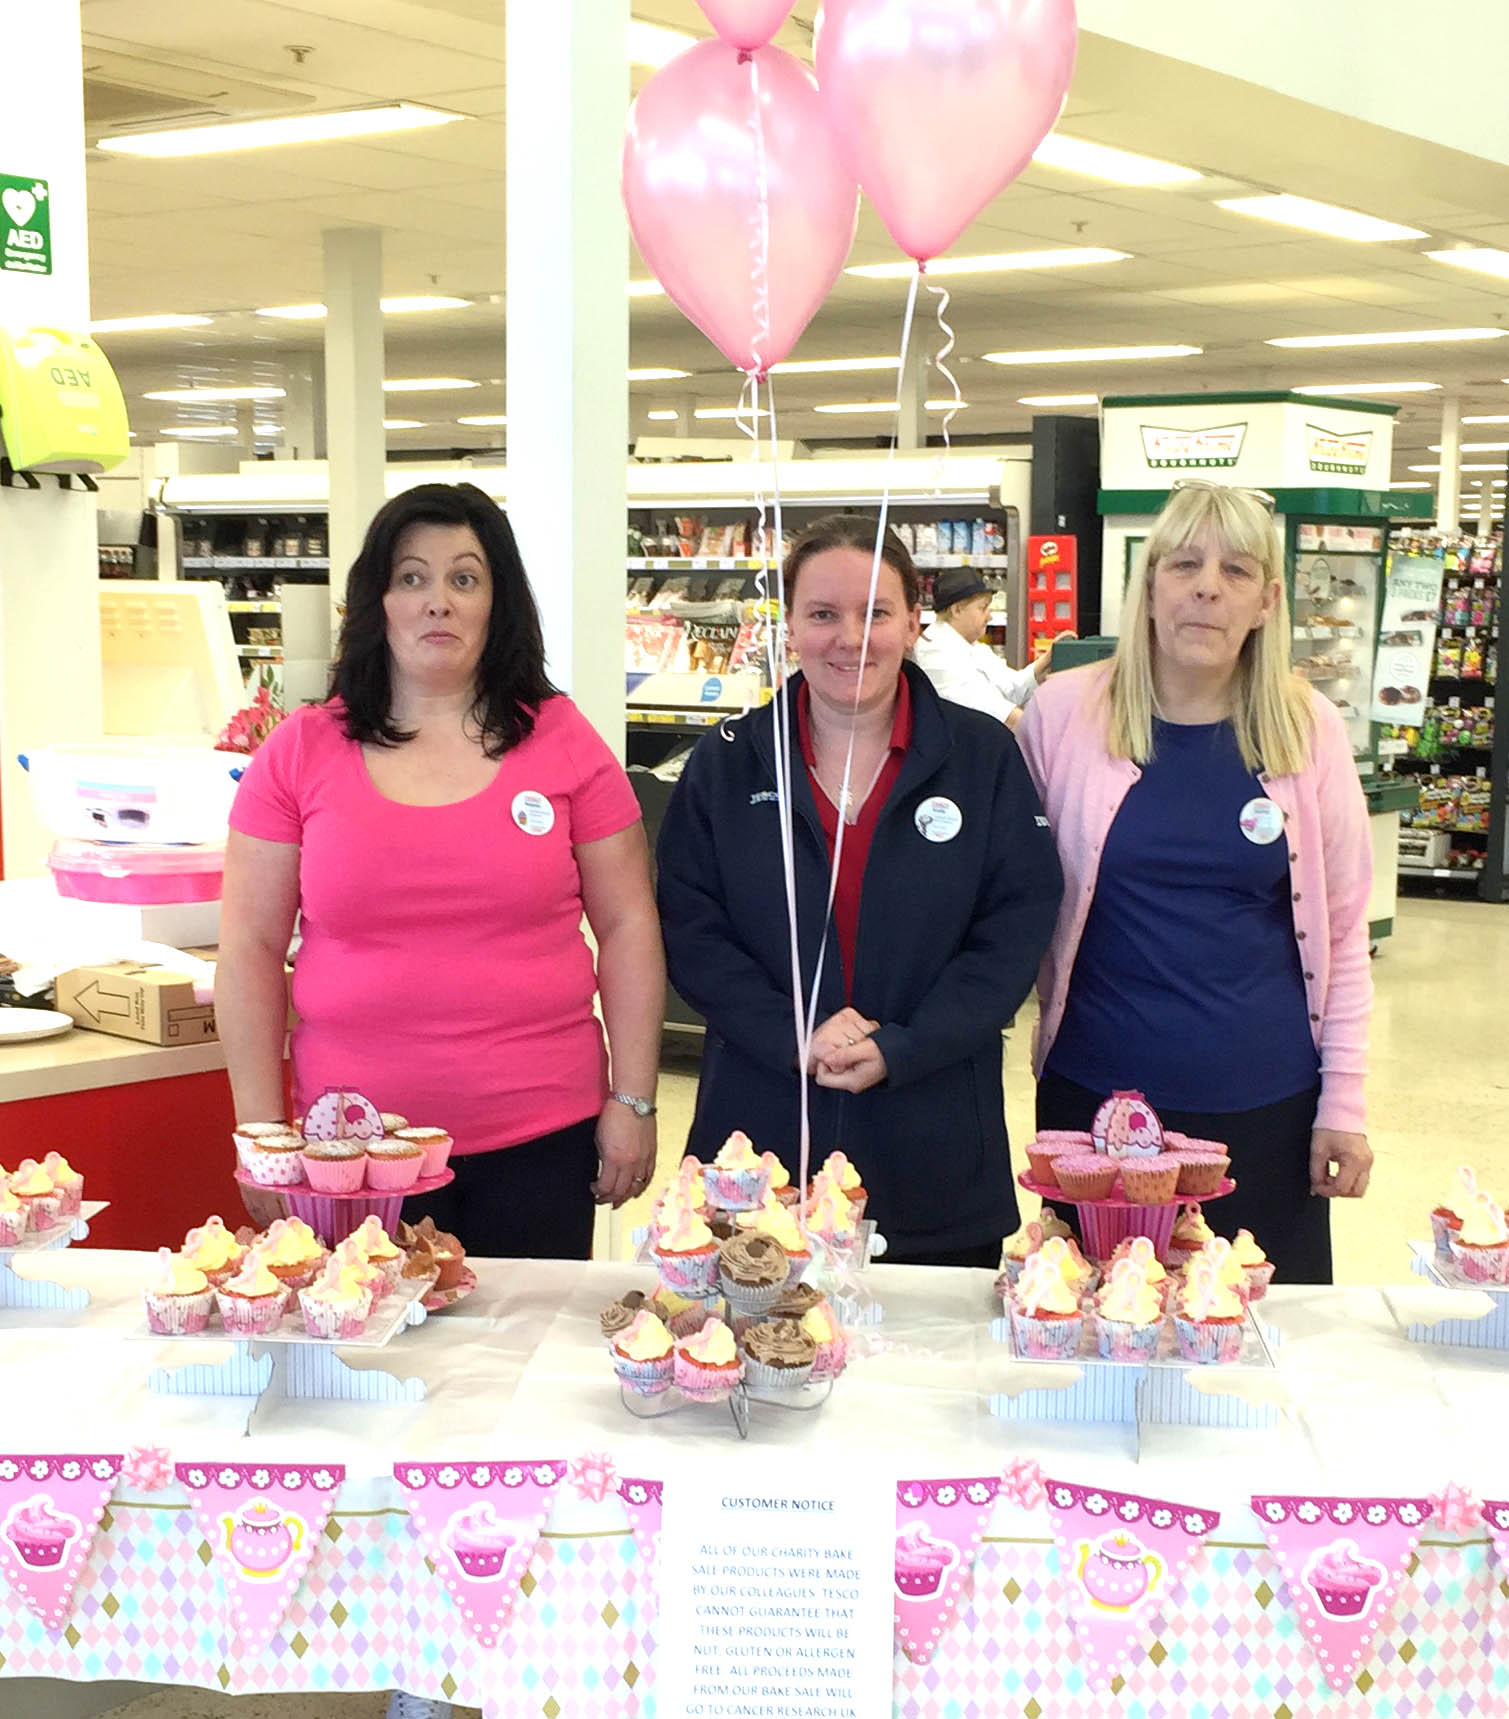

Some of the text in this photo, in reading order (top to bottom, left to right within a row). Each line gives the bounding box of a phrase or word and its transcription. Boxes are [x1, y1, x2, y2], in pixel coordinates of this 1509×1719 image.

[7, 228, 44, 249] AED
[51, 367, 91, 387] AED
[722, 1498, 834, 1510] CUSTOMER NOTICE
[700, 1545, 853, 1560] ALL OF OUR CHARITY BAKE
[692, 1565, 861, 1580] SALE PRODUCTS WERE MADE
[693, 1584, 706, 1595] BY
[711, 1585, 736, 1597] OUR
[823, 1588, 859, 1599] TESCO
[696, 1606, 854, 1618] CANNOT GUARANTEE THAT
[700, 1625, 848, 1638] THESE PRODUCTS WILL BE
[726, 1646, 772, 1657] GLUTEN
[776, 1647, 792, 1657] OR
[796, 1648, 855, 1658] ALLERGEN
[730, 1666, 748, 1676] ALL
[753, 1666, 814, 1678] PROCEEDS
[817, 1668, 852, 1678] MADE
[693, 1685, 852, 1698] FROM OUR BAKE SALE WILL
[686, 1704, 856, 1718] GO TO CANCER RESEARCH UK
